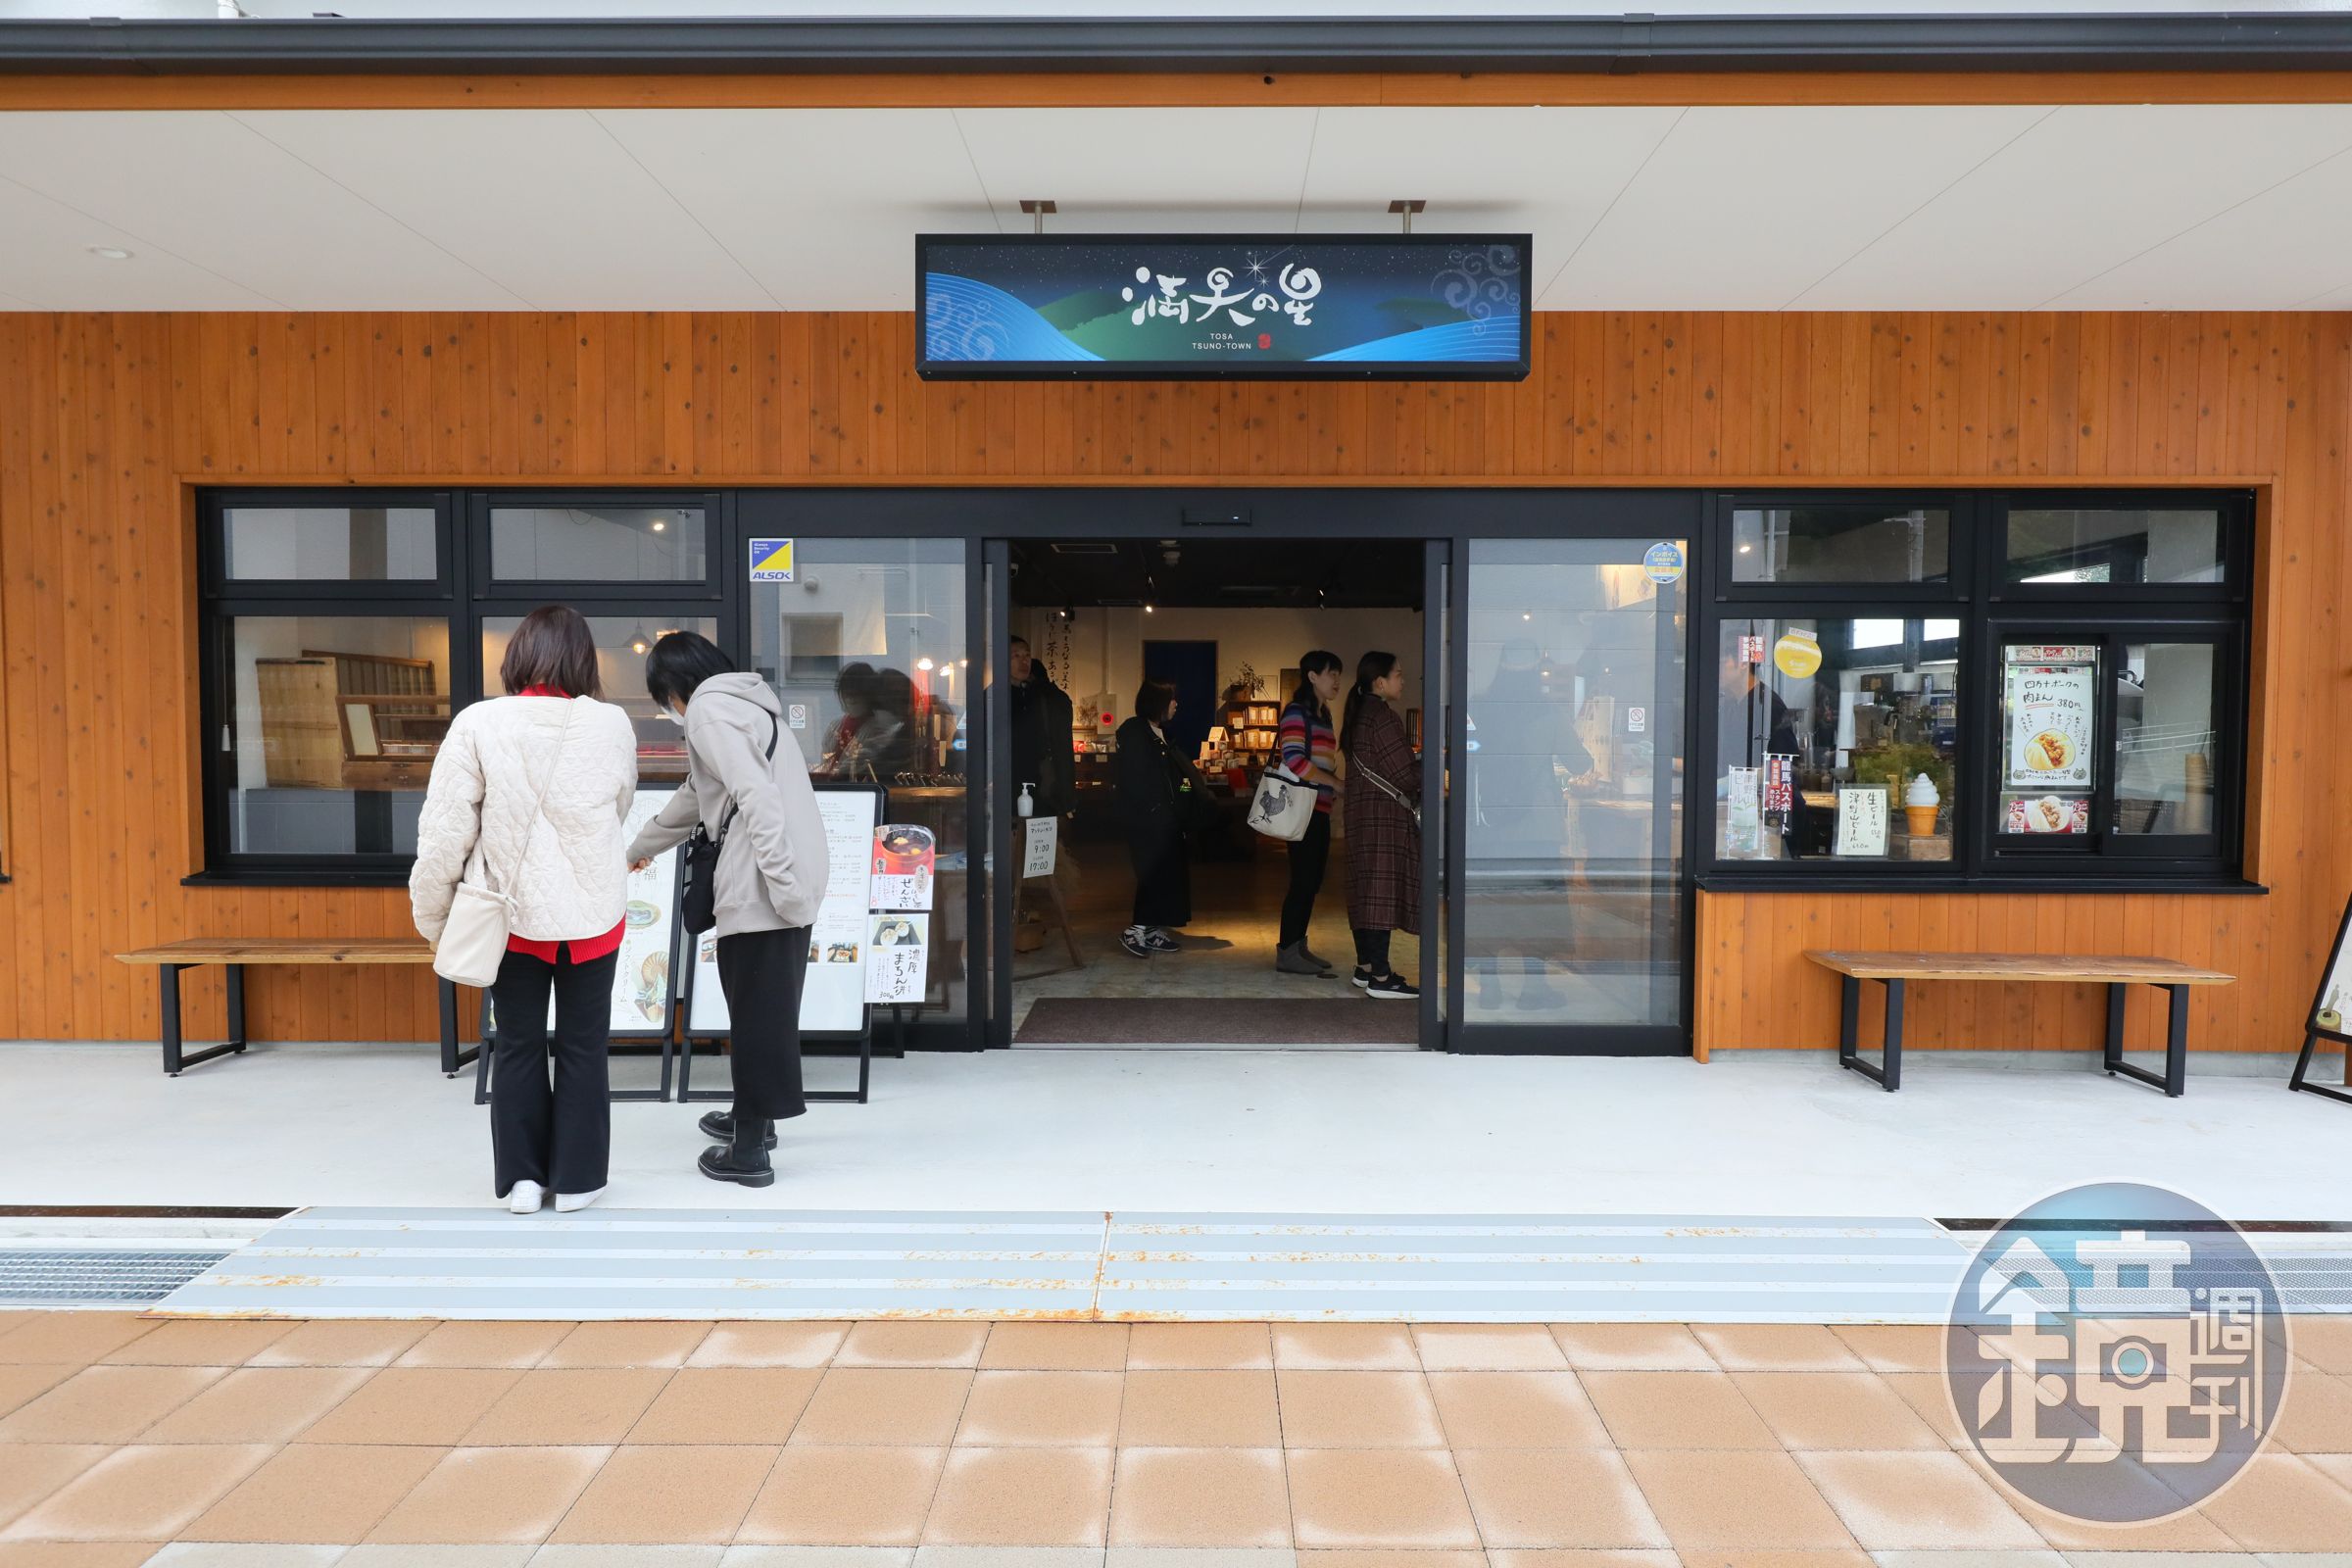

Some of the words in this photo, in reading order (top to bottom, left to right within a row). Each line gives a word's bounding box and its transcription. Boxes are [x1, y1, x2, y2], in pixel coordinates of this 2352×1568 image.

[1122, 263, 1322, 326] 満天の星
[753, 571, 791, 580] ALSOK
[2023, 691, 2054, 704] 肉まん
[1781, 760, 1791, 835] 龍馬パスポート
[1867, 792, 1879, 826] 生ビール
[1035, 844, 1050, 854] 9:00
[1029, 860, 1049, 871] 17:00
[899, 878, 913, 907] ぜんざい
